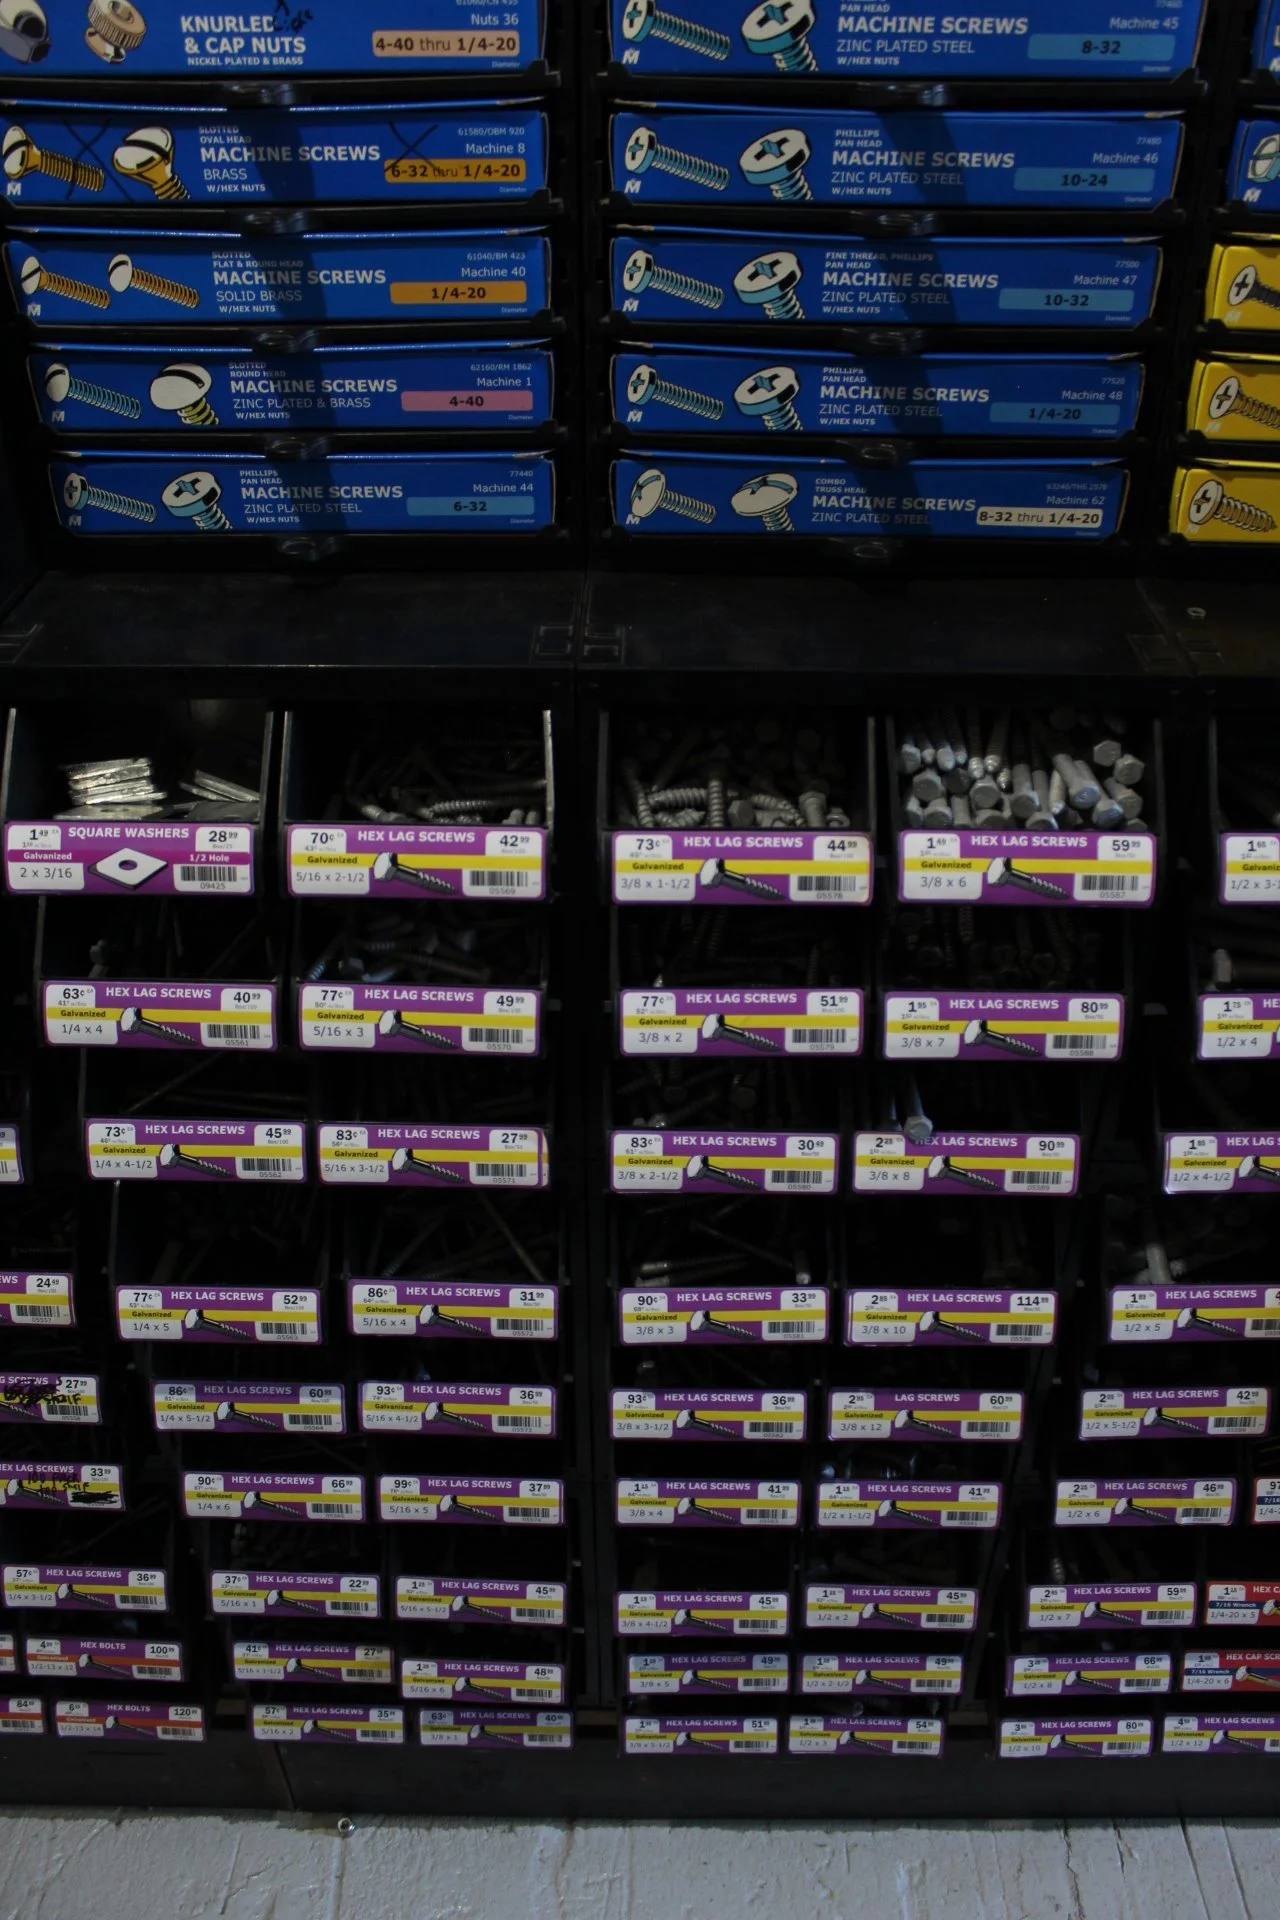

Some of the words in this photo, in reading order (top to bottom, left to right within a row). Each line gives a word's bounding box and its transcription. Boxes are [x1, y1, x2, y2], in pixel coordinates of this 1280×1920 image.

[181, 15, 274, 32] KNURLED
[471, 14, 499, 25] Nuts
[504, 13, 519, 25] 36
[1110, 17, 1159, 29] Machine
[1163, 17, 1178, 29] 45
[838, 16, 935, 32] MACHINE
[941, 17, 1028, 34] SCREWS
[184, 37, 199, 54] &
[205, 37, 244, 53] CAP
[251, 36, 306, 53] NUTS
[376, 37, 414, 51] 4-40
[420, 38, 450, 50] thru
[458, 37, 516, 53] 1/4-20
[1082, 40, 1120, 54] 8-32
[224, 57, 260, 65] PLATED
[272, 56, 303, 65] BRASS
[466, 143, 513, 153] Machine
[518, 142, 525, 153] 8
[200, 147, 290, 162] MACHINE
[299, 145, 380, 161] SCREWS
[832, 150, 925, 166] MACHINE
[931, 152, 1014, 168] SCREWS
[1092, 153, 1140, 163] Machine
[1143, 153, 1158, 163] 46
[203, 168, 247, 180] BRASS
[392, 165, 428, 177] 6-32
[433, 166, 457, 178] thru
[464, 164, 520, 178] 1/4-20
[1062, 174, 1107, 186] 10-24
[213, 270, 301, 284] MACHINE
[308, 269, 386, 284] SCREWS
[461, 267, 507, 277] Machine
[511, 266, 526, 276] 40
[823, 272, 912, 286] MACHINE
[919, 273, 998, 288] SCREWS
[1074, 275, 1119, 284] Machine
[1122, 275, 1137, 284] 47
[216, 290, 255, 301] SOLID
[260, 290, 302, 301] BRASS
[432, 287, 486, 301] 1/4-20
[1045, 294, 1089, 306] 10-32
[230, 380, 314, 393] MACHINE
[322, 379, 397, 392] SCREWS
[477, 377, 521, 386] Machine
[820, 385, 906, 399] MACHINE
[913, 387, 989, 402] SCREWS
[1062, 390, 1105, 400] Machine
[1108, 391, 1122, 400] 48
[233, 398, 263, 408] ZINC
[267, 398, 312, 408] PLATED
[330, 397, 371, 408] BRASS
[449, 395, 484, 406] 4-40
[1029, 408, 1081, 420] 1/4-20
[239, 470, 278, 479] PHILLIPS
[241, 486, 322, 499] MACHINE
[330, 486, 402, 498] SCREWS
[473, 484, 516, 492] Machine
[244, 504, 273, 513] ZINC
[277, 503, 320, 513] PLATED
[325, 503, 361, 512] STEEL
[454, 501, 487, 511] 6-32
[813, 495, 896, 508] MACHINE
[902, 498, 977, 511] SCREWS
[979, 511, 1012, 523] 8-32
[1018, 512, 1043, 523] thru
[1049, 513, 1100, 525] 1/4-20
[68, 827, 120, 839] SQUARE
[125, 827, 189, 838] WASHERS
[358, 830, 384, 840] HEX
[389, 831, 414, 841] LAG
[419, 831, 475, 842] SCREWS
[684, 836, 711, 846] HEX
[715, 836, 742, 847] LAG
[746, 836, 803, 847] SCREWS
[971, 835, 998, 845] HEX
[1002, 836, 1028, 846] LAG
[1032, 836, 1087, 847] SCREWS
[23, 852, 72, 861] Galvanized
[190, 853, 206, 862] 1/2
[209, 853, 230, 862] Hole
[307, 856, 357, 864] Galvanized
[20, 867, 26, 877] 2
[44, 867, 72, 879] 3/16
[200, 881, 225, 890] 09425
[920, 876, 941, 888] 3/8
[958, 877, 966, 887] 6
[106, 987, 129, 996] HEX
[133, 987, 156, 997] LAG
[160, 988, 211, 998] SCREWS
[364, 989, 389, 999] HEX
[393, 990, 417, 1000] LAG
[421, 990, 474, 1001] SCREWS
[686, 993, 711, 1003] HEX
[716, 993, 740, 1003] LAG
[744, 993, 797, 1003] SCREWS
[950, 999, 974, 1008] HEX
[978, 999, 1003, 1009] LAG
[1006, 999, 1059, 1009] SCREWS
[60, 1009, 106, 1018] Galvanized
[62, 1024, 80, 1034] 1/4
[95, 1025, 102, 1033] 4
[314, 1026, 341, 1037] 5/16
[357, 1027, 364, 1037] 3
[145, 1125, 167, 1133] HEX
[171, 1125, 193, 1134] LAG
[197, 1125, 245, 1134] SCREWS
[378, 1129, 401, 1138] HEX
[405, 1129, 427, 1138] LAG
[431, 1129, 480, 1139] SCREWS
[673, 1136, 697, 1145] HEX
[700, 1136, 723, 1145] LAG
[727, 1136, 776, 1146] SCREWS
[171, 1291, 192, 1299] HEX
[196, 1292, 216, 1300] LAG
[219, 1292, 264, 1300] SCREWS
[677, 1293, 698, 1301] HEX
[702, 1292, 723, 1301] LAG
[726, 1291, 772, 1300] SCREWS
[907, 1294, 929, 1302] HEX
[932, 1294, 953, 1302] LAG
[956, 1294, 1002, 1302] SCREWS
[436, 1386, 456, 1394] LAG
[459, 1386, 501, 1395] SCREWS
